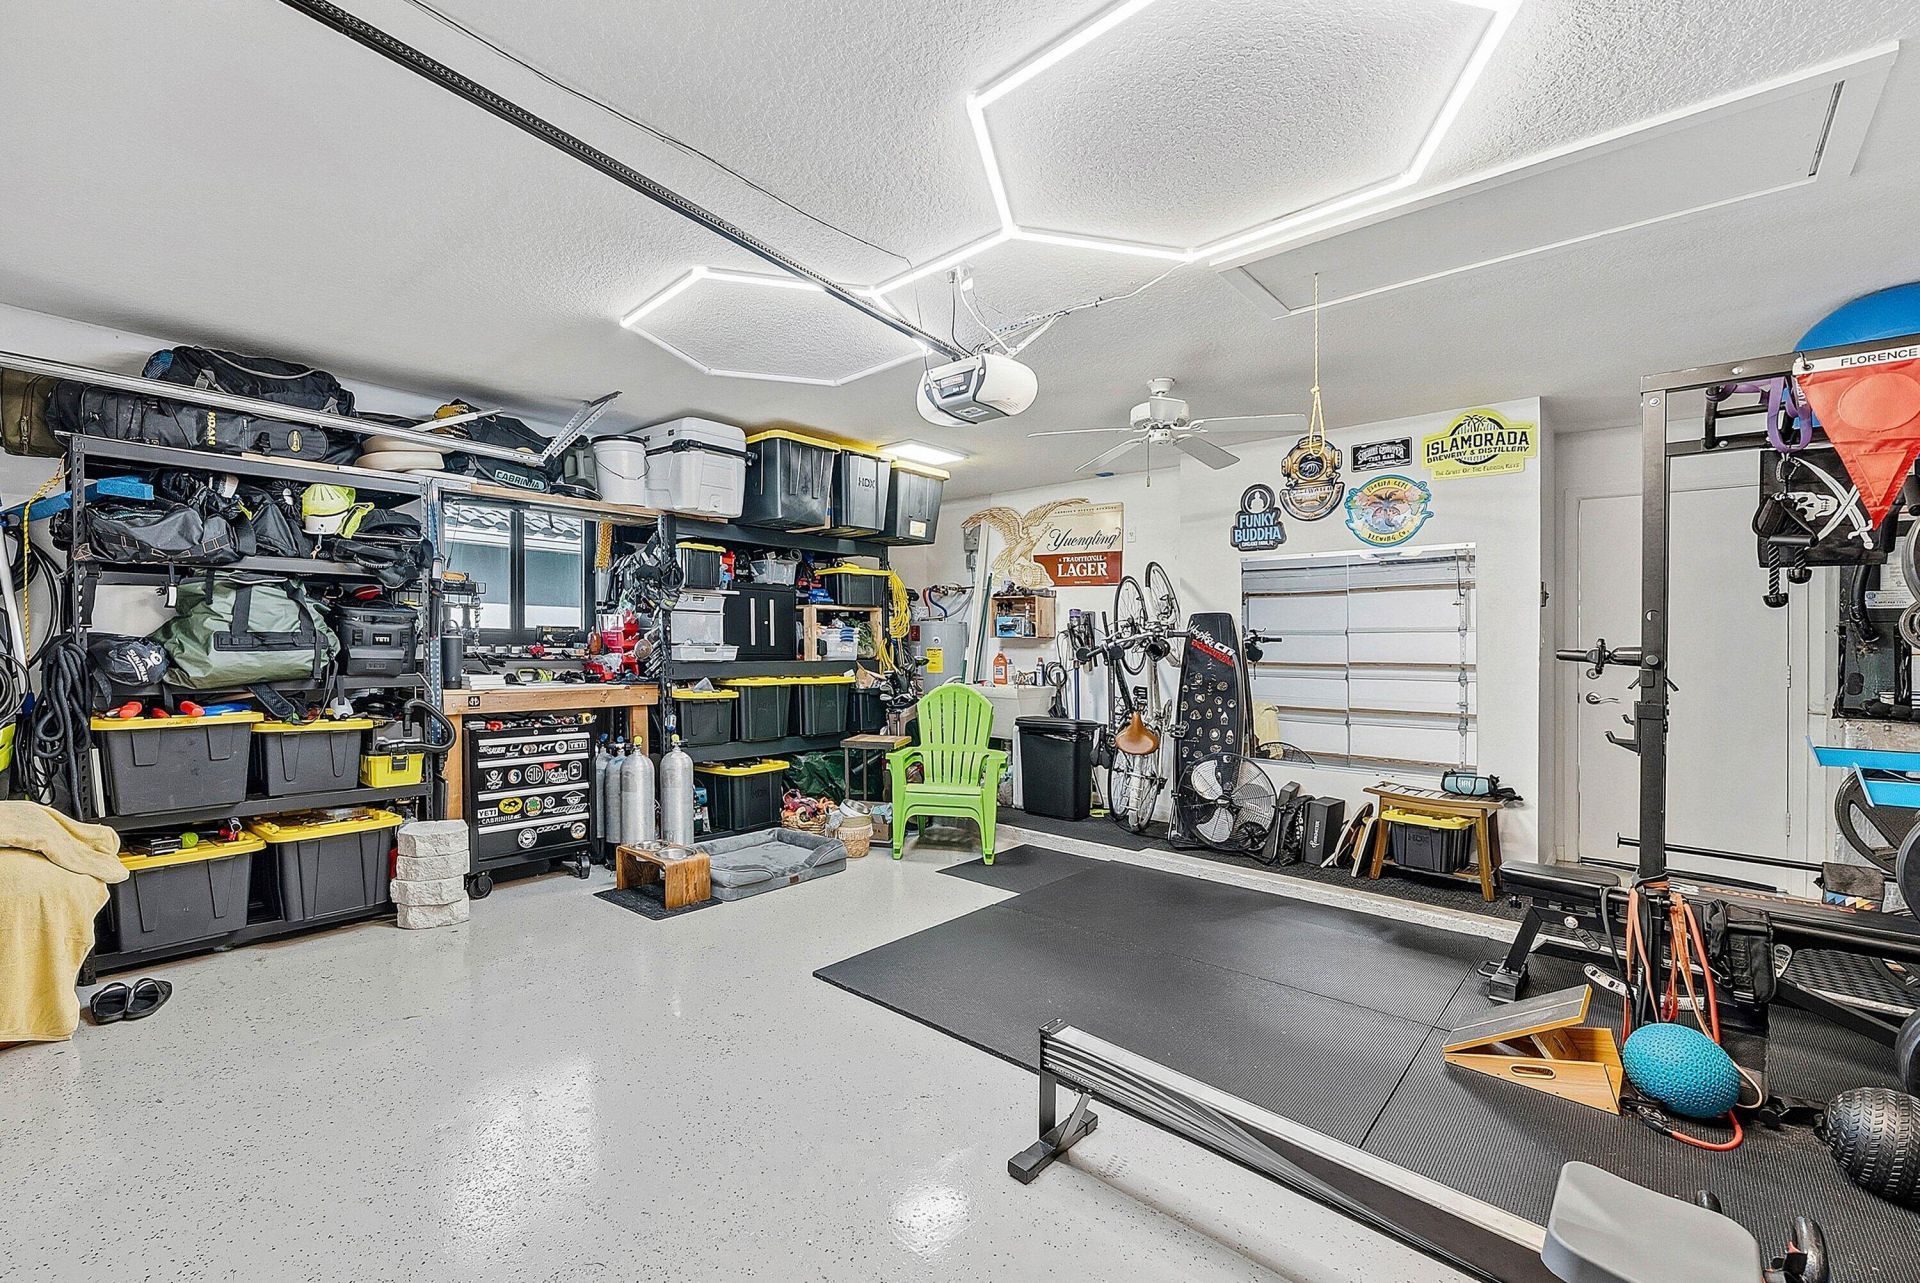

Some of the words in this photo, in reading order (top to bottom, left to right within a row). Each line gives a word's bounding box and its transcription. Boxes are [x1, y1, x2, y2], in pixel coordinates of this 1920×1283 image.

[1840, 348, 1918, 366] FLORENCE
[1426, 431, 1530, 457] ISLAMORADA
[1427, 450, 1467, 463] BREWERY
[1478, 446, 1530, 454] DISTILLERY
[858, 476, 876, 489] HDX
[1239, 512, 1276, 529] FUNKY
[1046, 526, 1121, 552] Yuengling
[1234, 526, 1282, 542] BUDDHA
[1062, 554, 1104, 563] TRADITIONAL
[1057, 562, 1108, 577] LAGER
[527, 766, 542, 782] SIG
[479, 809, 497, 817] YETI
